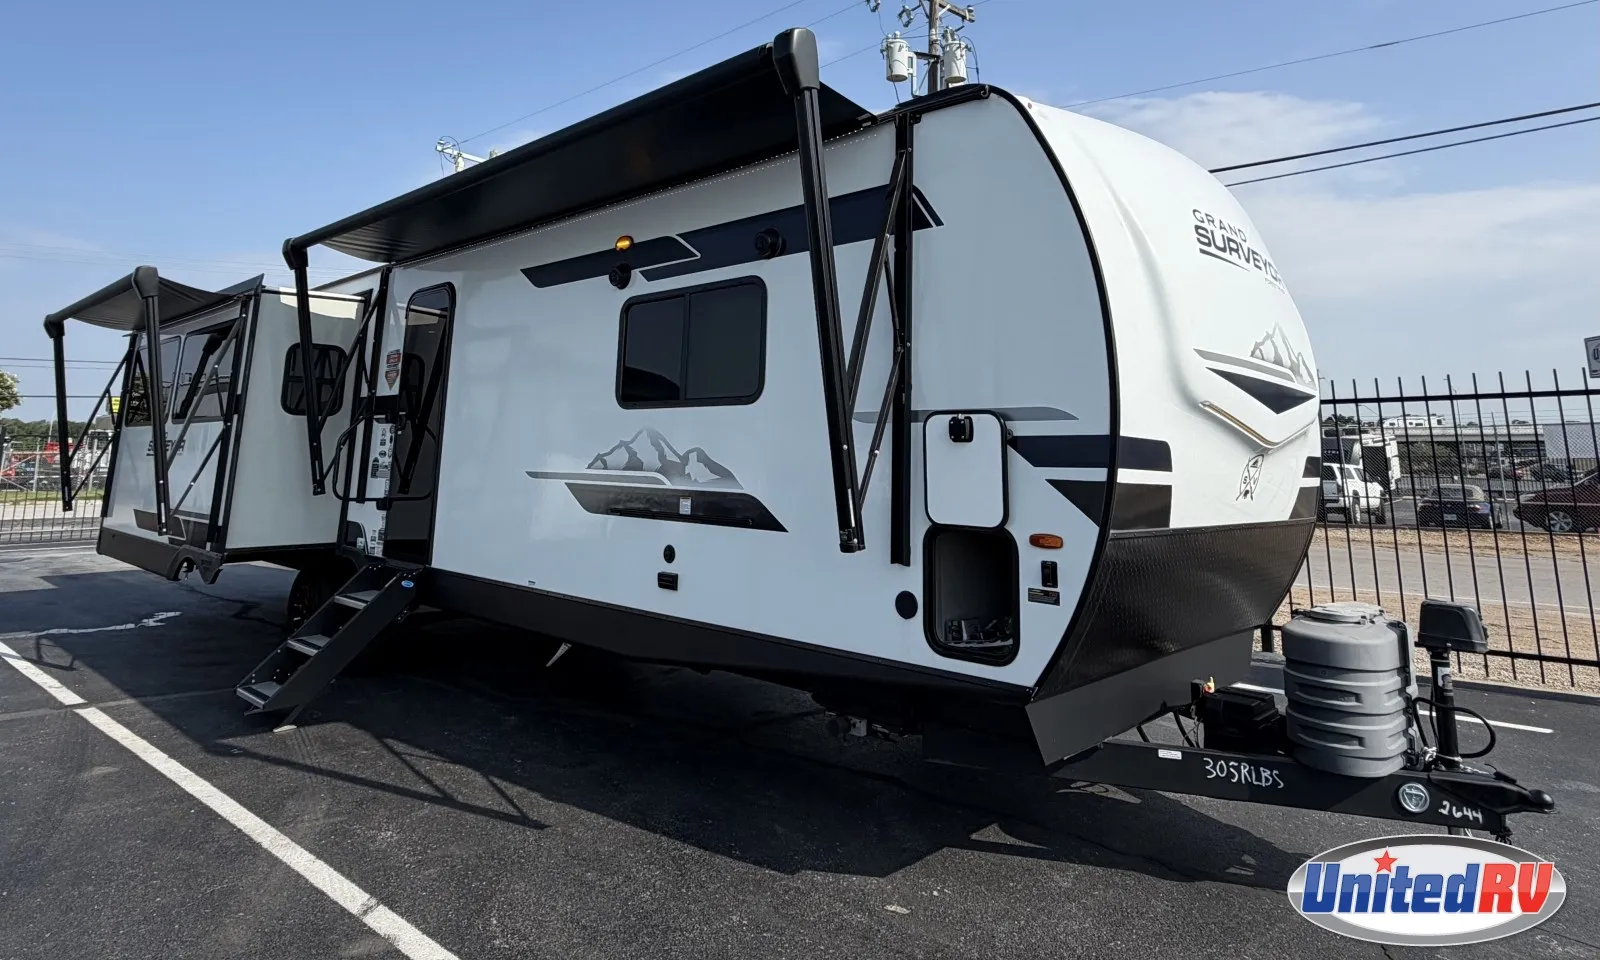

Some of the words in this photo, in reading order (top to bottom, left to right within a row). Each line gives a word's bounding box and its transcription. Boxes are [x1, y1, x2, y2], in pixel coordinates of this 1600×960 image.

[1192, 208, 1247, 243] GRAND
[1203, 757, 1285, 789] 305RLBS
[1438, 800, 1484, 825] 2644
